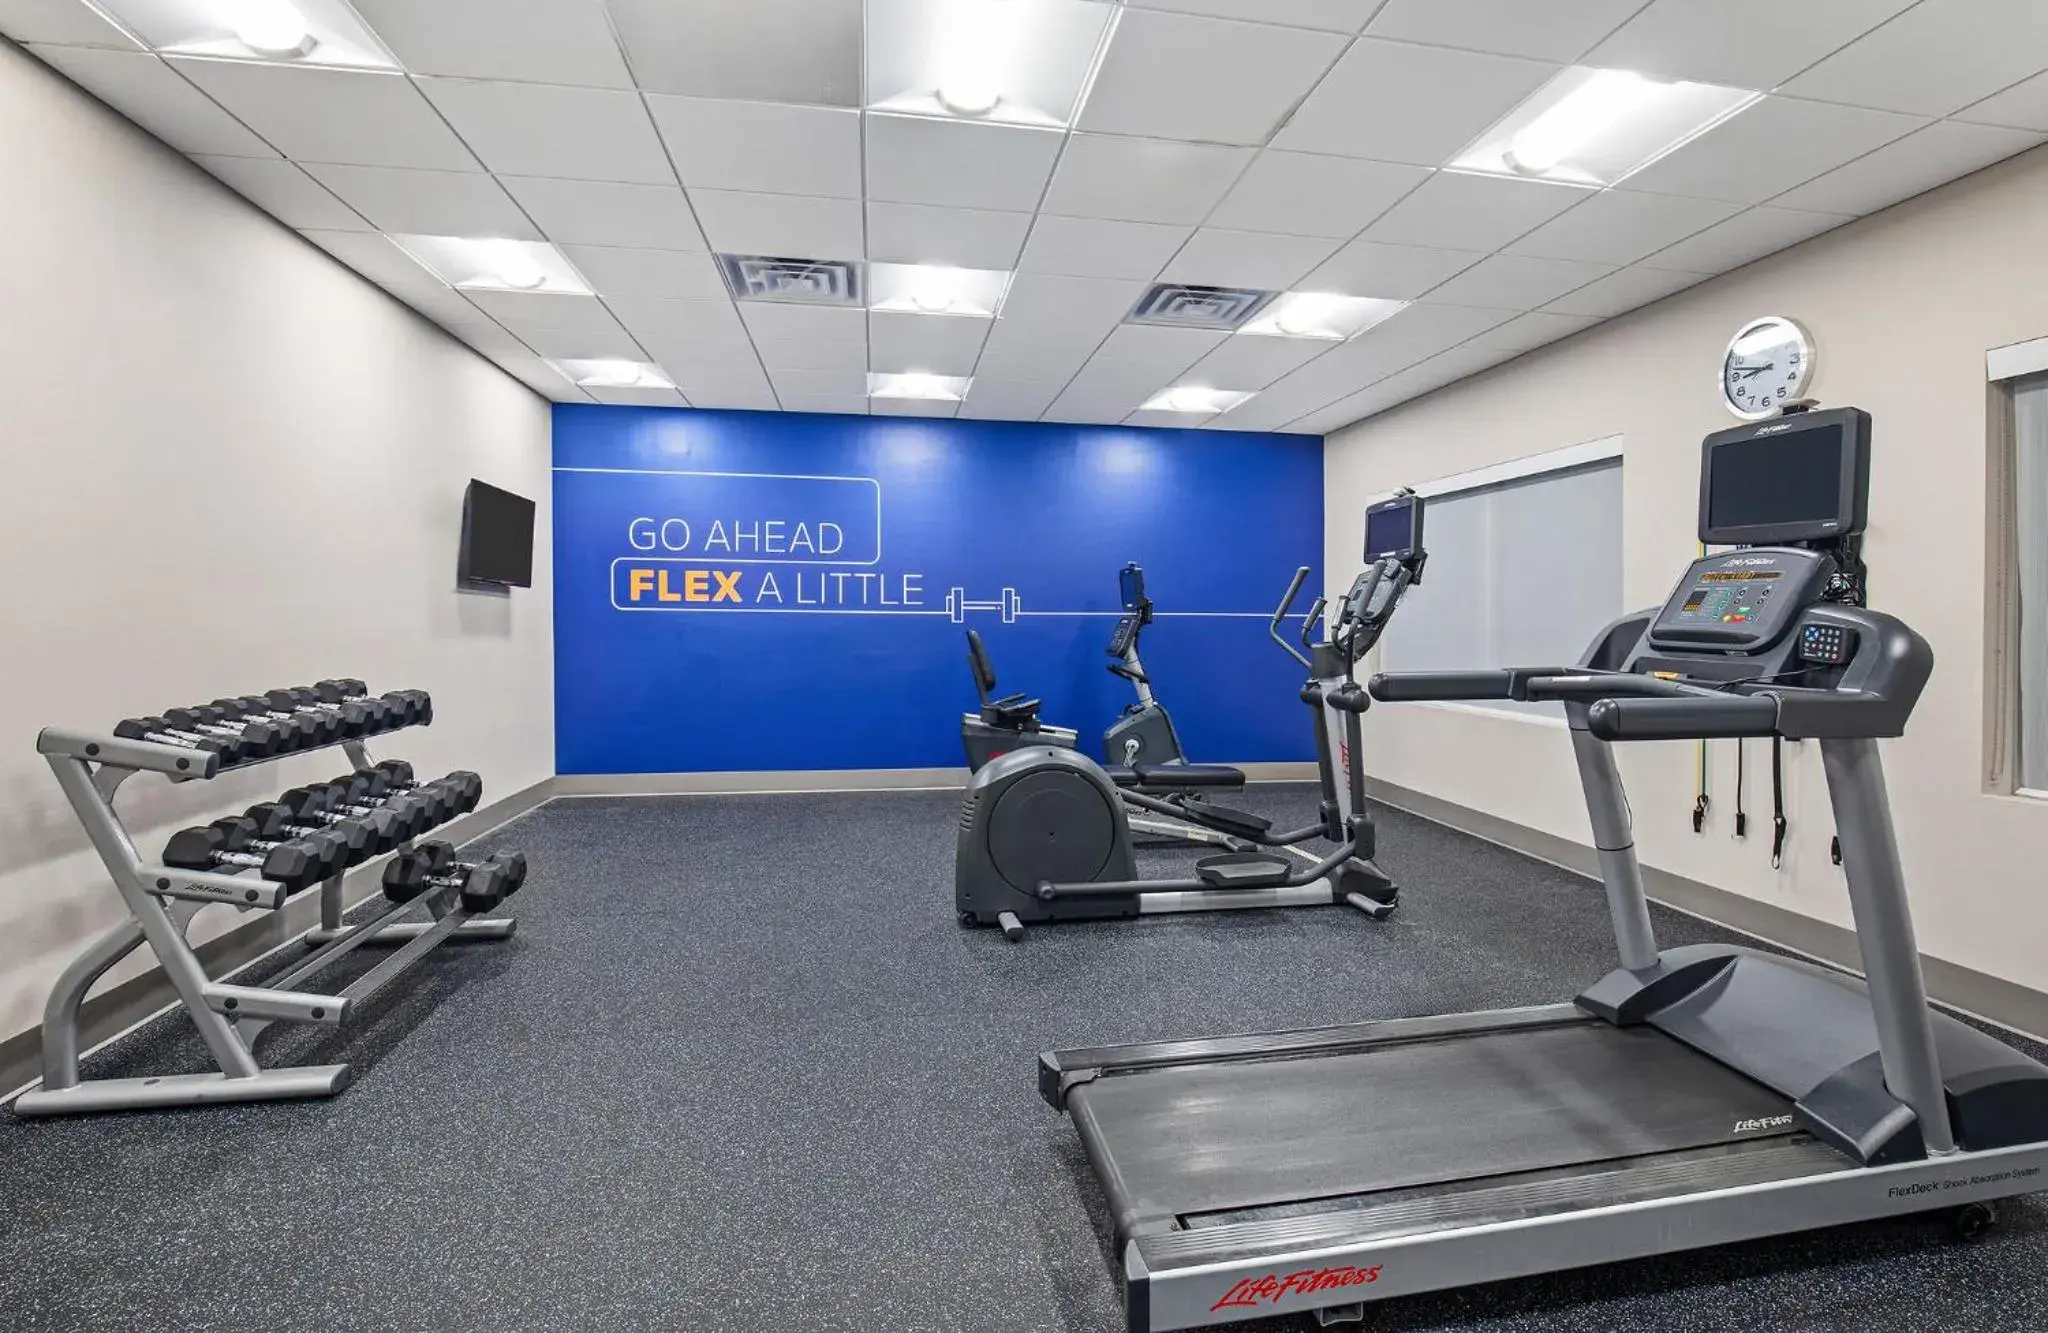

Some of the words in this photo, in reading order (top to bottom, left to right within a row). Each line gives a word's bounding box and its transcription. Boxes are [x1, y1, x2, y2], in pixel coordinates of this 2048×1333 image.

[1732, 372, 1740, 382] 9
[1787, 372, 1796, 380] 4
[1737, 386, 1745, 396] 8
[1777, 386, 1787, 398] 5
[1747, 395, 1756, 406] 7
[1761, 396, 1770, 407] 6
[628, 517, 691, 551] GO
[704, 519, 844, 555] AHEAD
[629, 569, 743, 603] FLEX
[756, 572, 783, 604] A
[797, 572, 925, 606] LITTLE
[1888, 1181, 1940, 1198] FlexDeck
[2012, 1167, 2041, 1180] System
